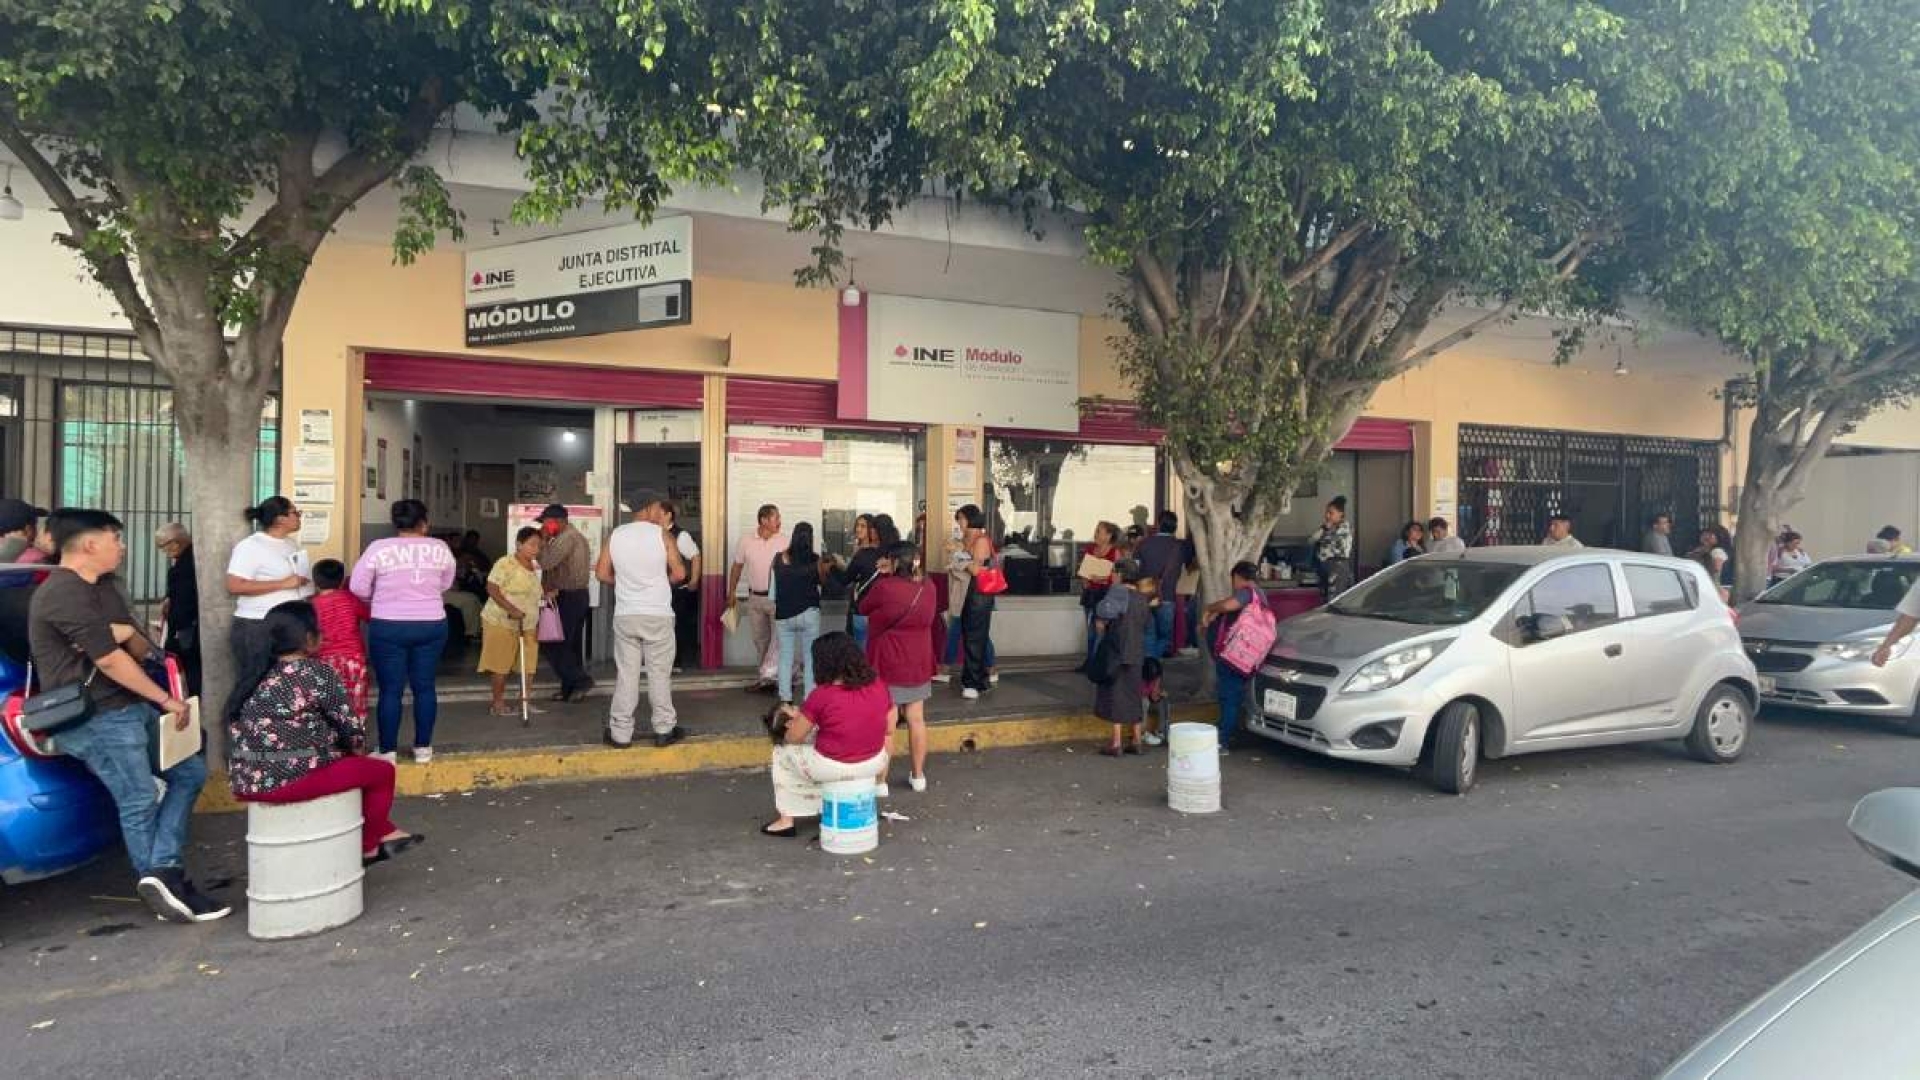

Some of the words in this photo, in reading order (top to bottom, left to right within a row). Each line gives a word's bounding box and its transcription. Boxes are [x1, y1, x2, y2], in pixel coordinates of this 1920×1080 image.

[558, 251, 603, 271] JUNTA
[606, 239, 682, 263] DISTRITAL
[486, 270, 515, 285] INE
[579, 263, 657, 288] EJECUTIVA
[468, 300, 575, 329] MÓDULO
[913, 347, 955, 362] INE
